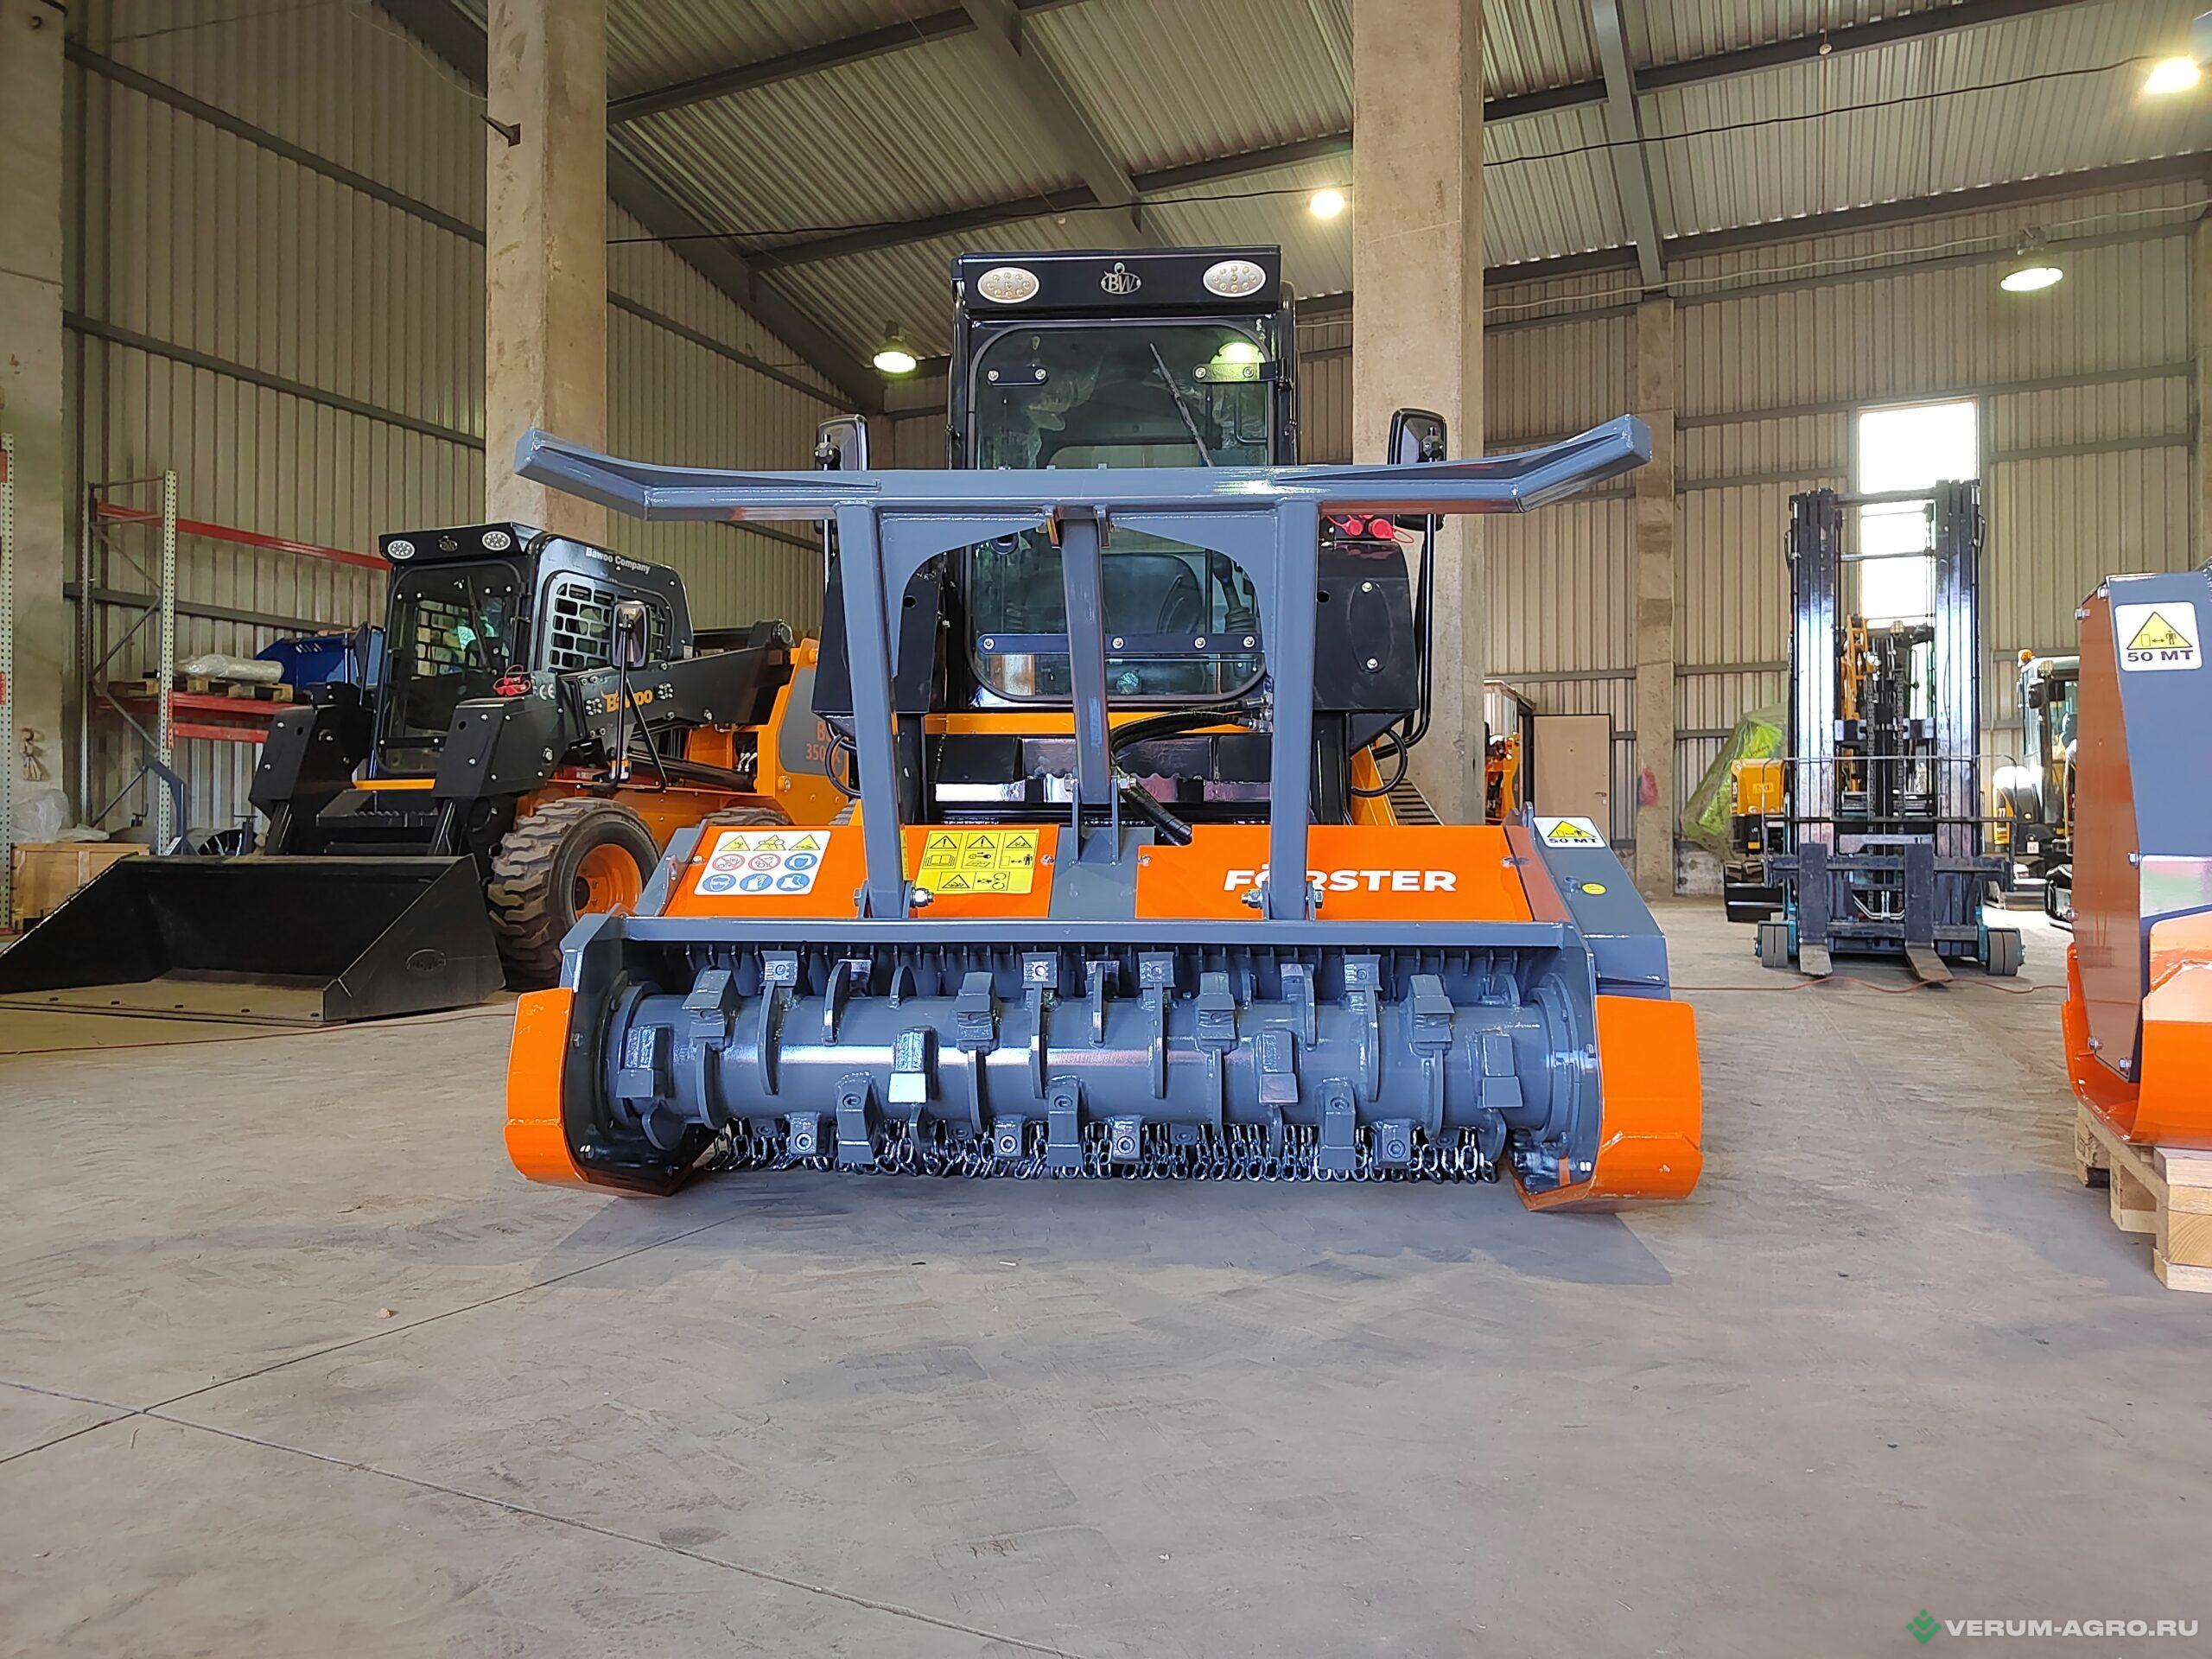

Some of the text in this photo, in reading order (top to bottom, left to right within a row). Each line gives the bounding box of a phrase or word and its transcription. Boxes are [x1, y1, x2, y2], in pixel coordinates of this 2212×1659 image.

[586, 547, 651, 575] Bawoo Company
[2127, 650, 2194, 662] 50 MT
